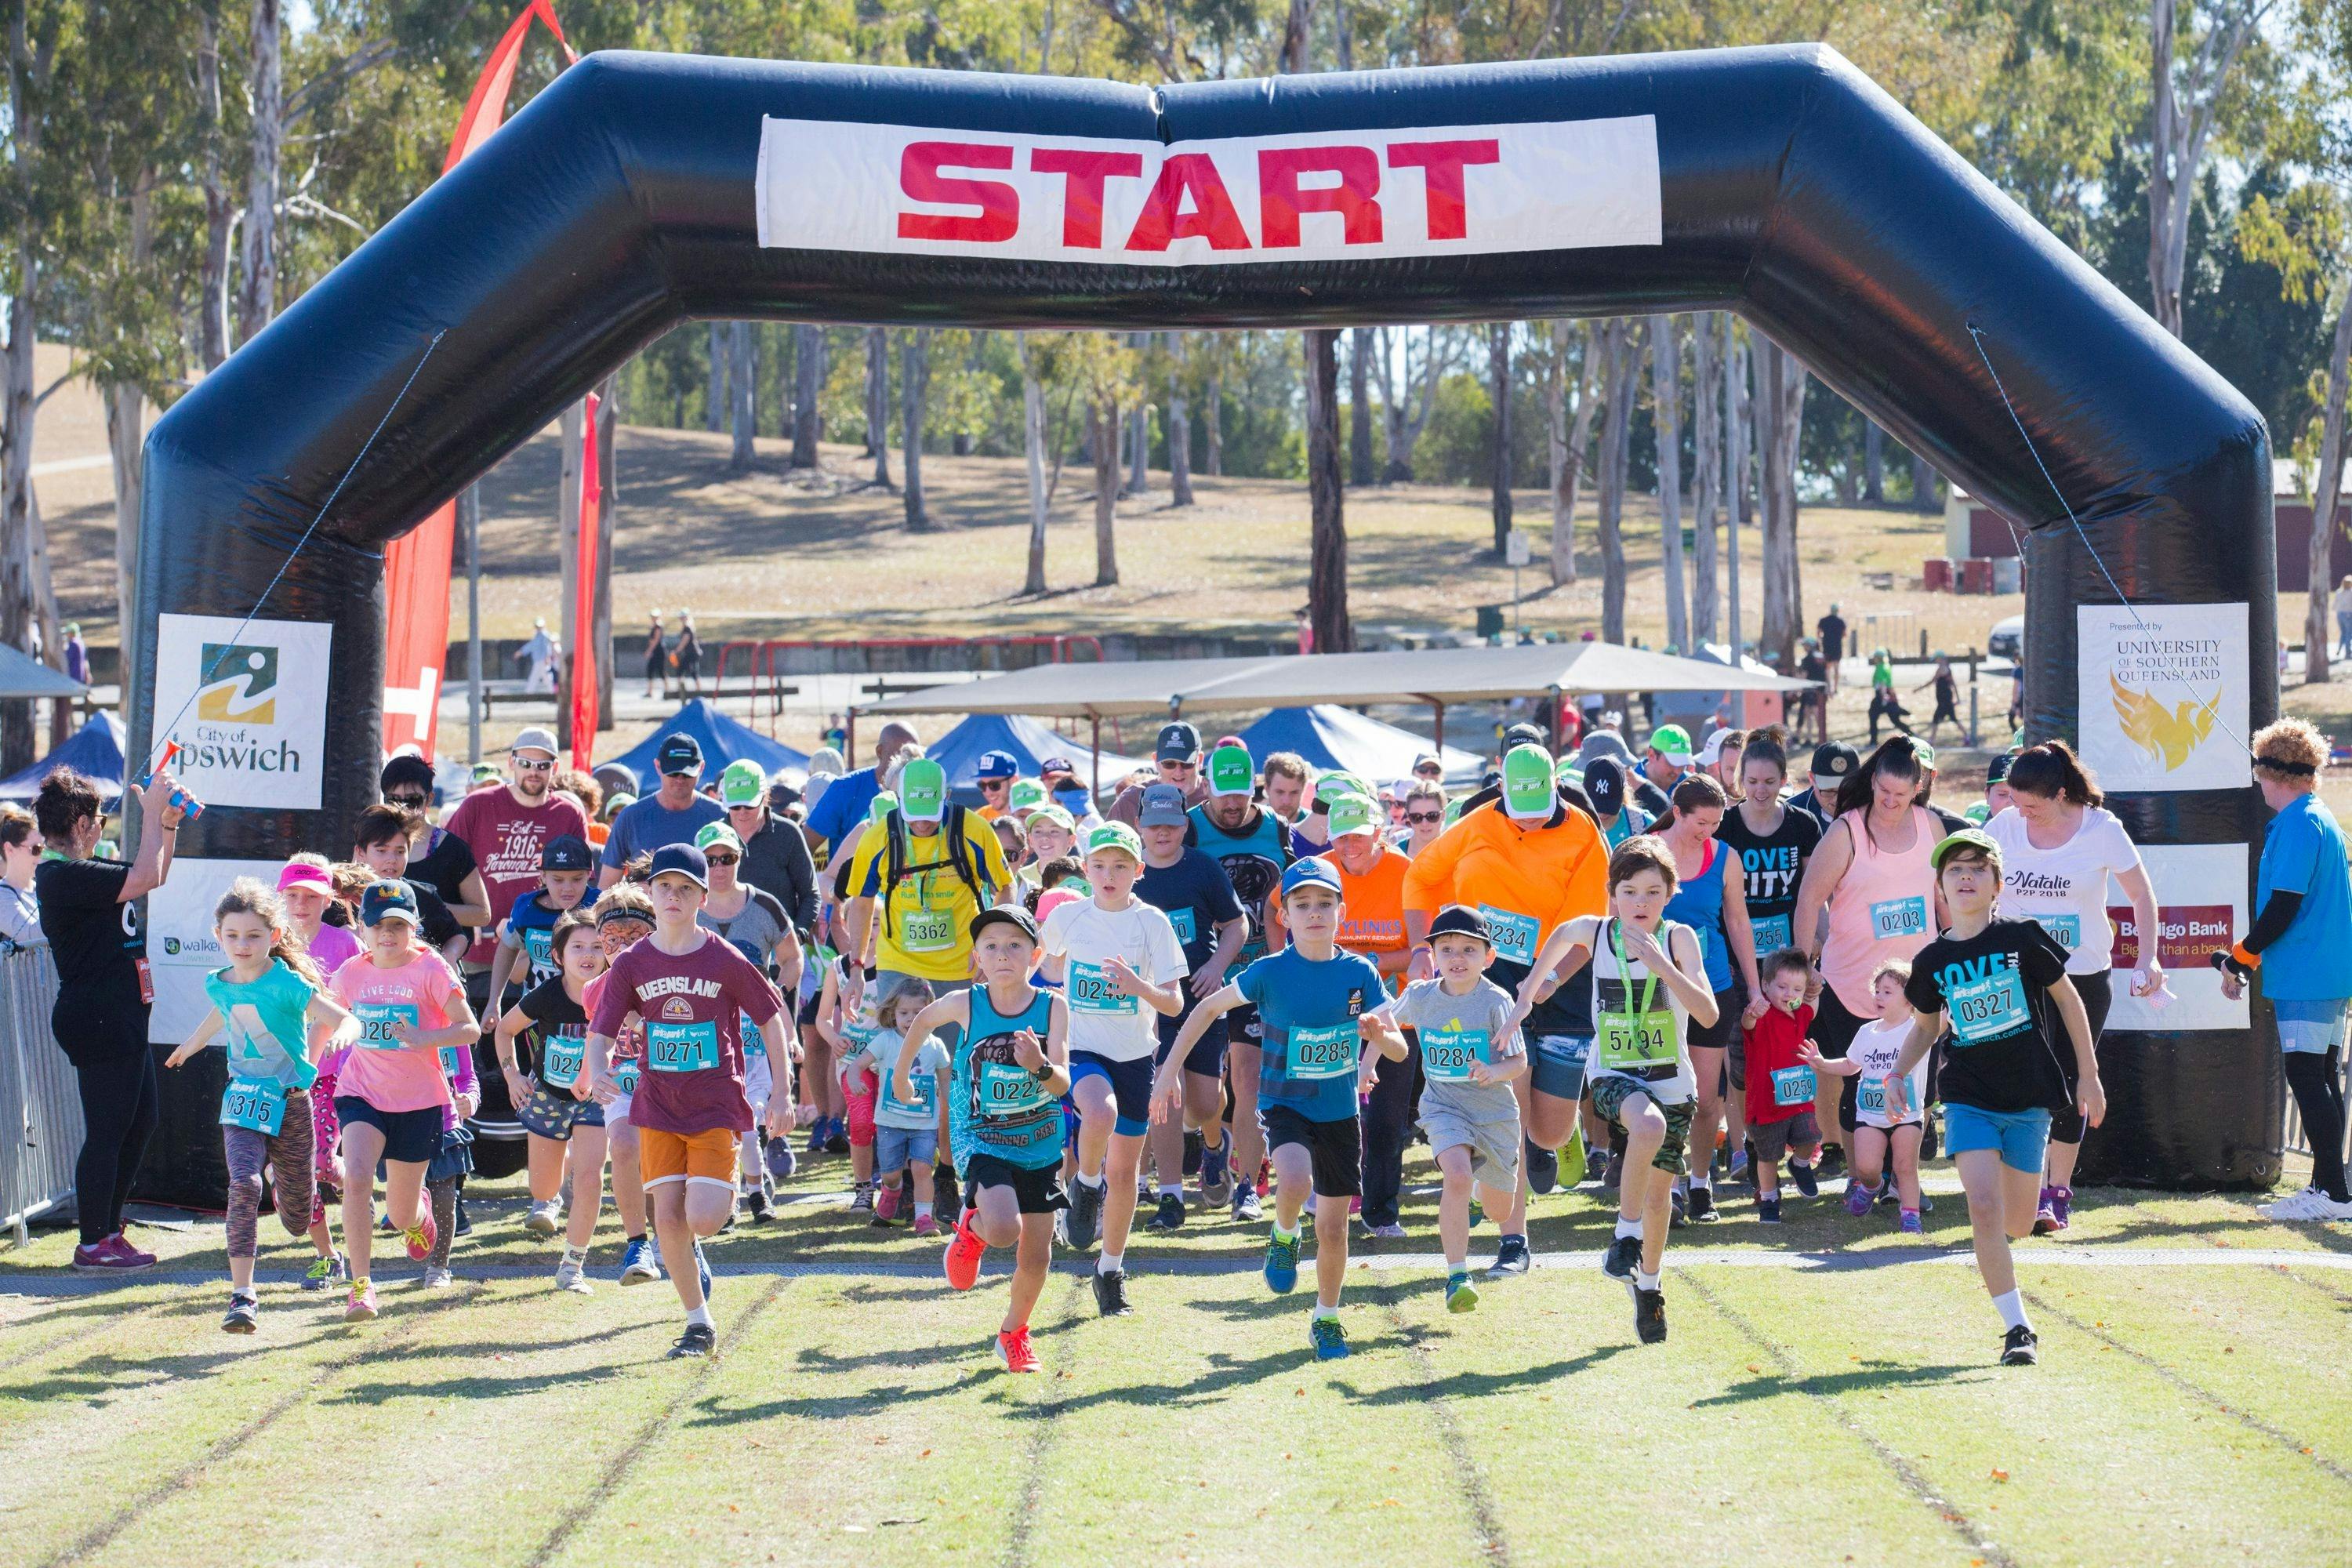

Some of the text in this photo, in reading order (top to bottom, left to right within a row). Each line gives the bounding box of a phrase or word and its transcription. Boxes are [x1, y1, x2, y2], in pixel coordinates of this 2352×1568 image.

[898, 139, 1499, 251] START
[2110, 622, 2162, 632] Presented by
[2118, 639, 2222, 655] UNIVERSITY
[2118, 655, 2220, 668] OF SOUTHERN
[2118, 669, 2220, 684] QUEENSLAND
[197, 726, 246, 742] City of
[502, 835, 538, 859] 1916
[1743, 846, 1798, 872] OVE THIS
[2005, 870, 2071, 890] Natalie
[2016, 888, 2035, 897] P2P
[1341, 919, 1403, 935] YLINKS
[1882, 910, 1920, 931] 0203
[2121, 920, 2227, 939] Beigo Bank
[909, 923, 948, 940] 5362
[1755, 928, 1784, 946] 255
[534, 943, 552, 959] 02
[2161, 943, 2189, 955] than
[2191, 946, 2199, 955] a
[361, 985, 413, 999] LIVE LOUD
[635, 976, 723, 1003] QUEENSLAND
[1961, 988, 2012, 1022] 0327
[743, 1031, 761, 1049] 23
[655, 1040, 703, 1062] 0271
[1300, 1039, 1350, 1064] 0285
[1428, 1047, 1475, 1067] 0284
[1864, 1047, 1900, 1063] Ameli
[550, 1054, 583, 1074] 024
[1784, 1078, 1813, 1098] 0259
[227, 1094, 272, 1123] 0315
[1865, 1092, 1885, 1108] 02
